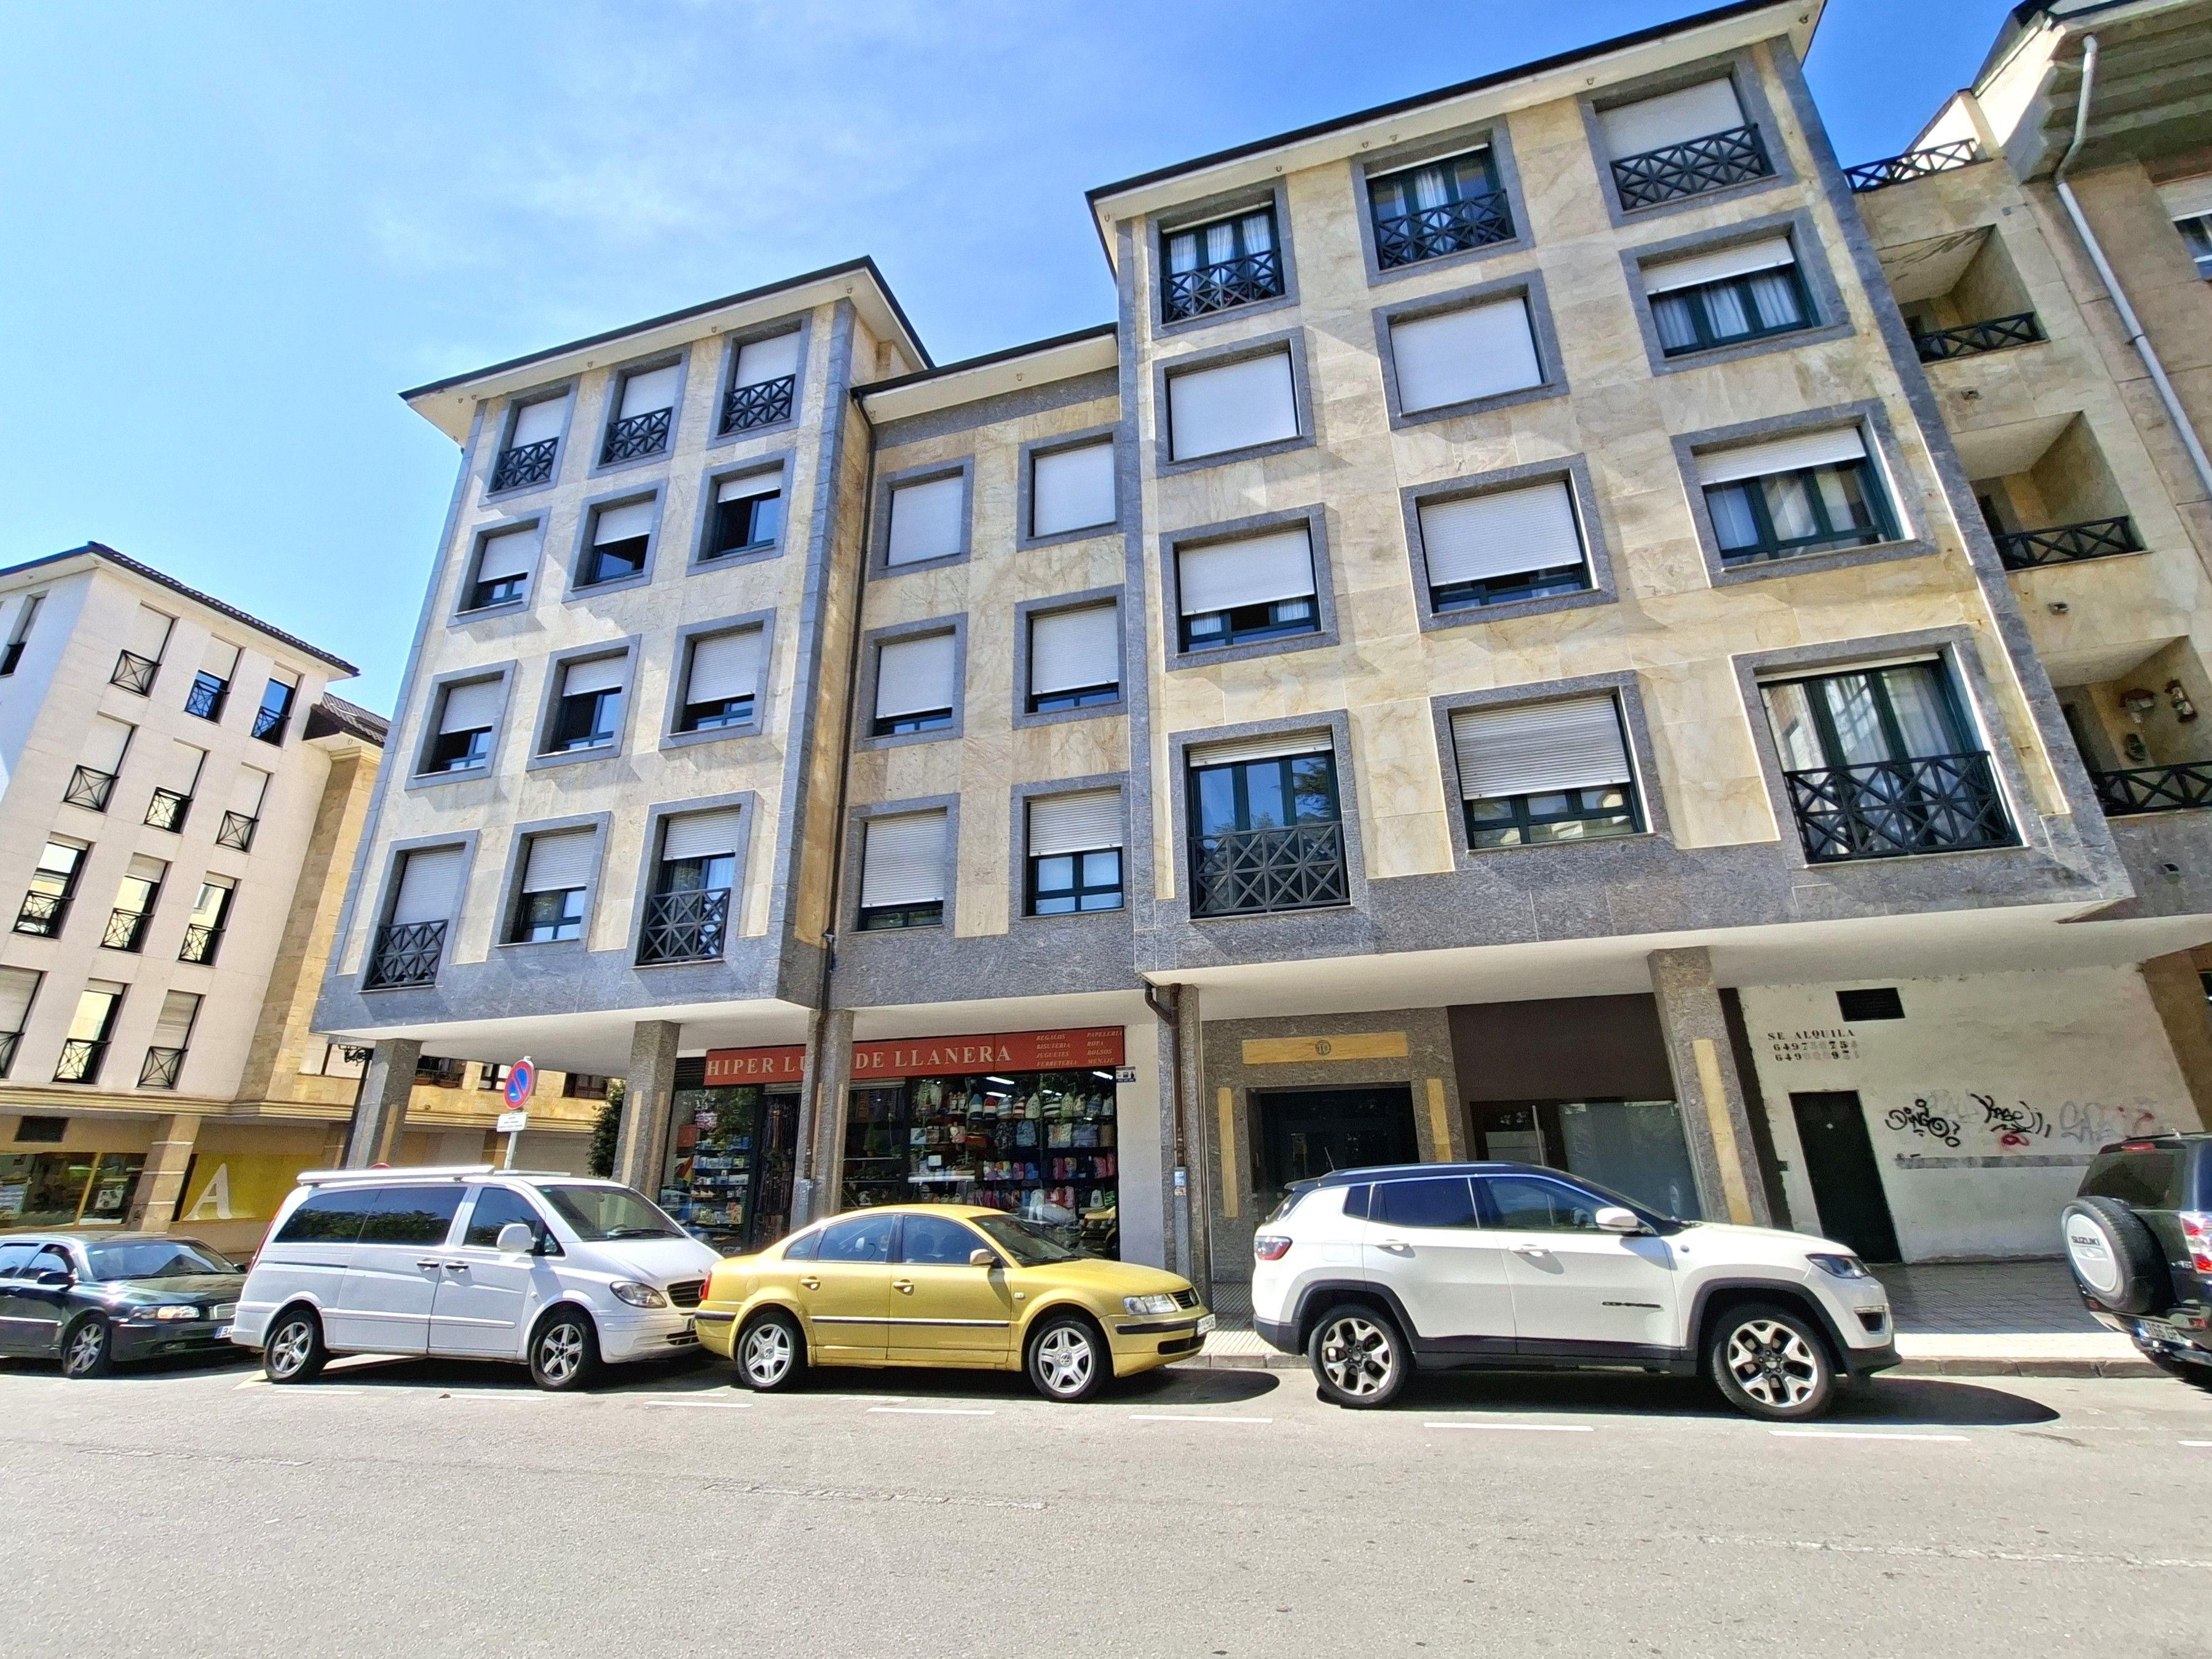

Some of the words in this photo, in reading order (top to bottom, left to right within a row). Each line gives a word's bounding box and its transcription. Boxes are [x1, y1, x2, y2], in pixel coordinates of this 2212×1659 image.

[1767, 1031, 1785, 1041] SE
[1795, 1028, 1855, 1039] ALQUILA
[707, 1057, 774, 1076] HIPER
[855, 1052, 885, 1070] DE
[895, 1045, 1012, 1068] LLANERA
[2071, 1235, 2101, 1246] SUZUKI
